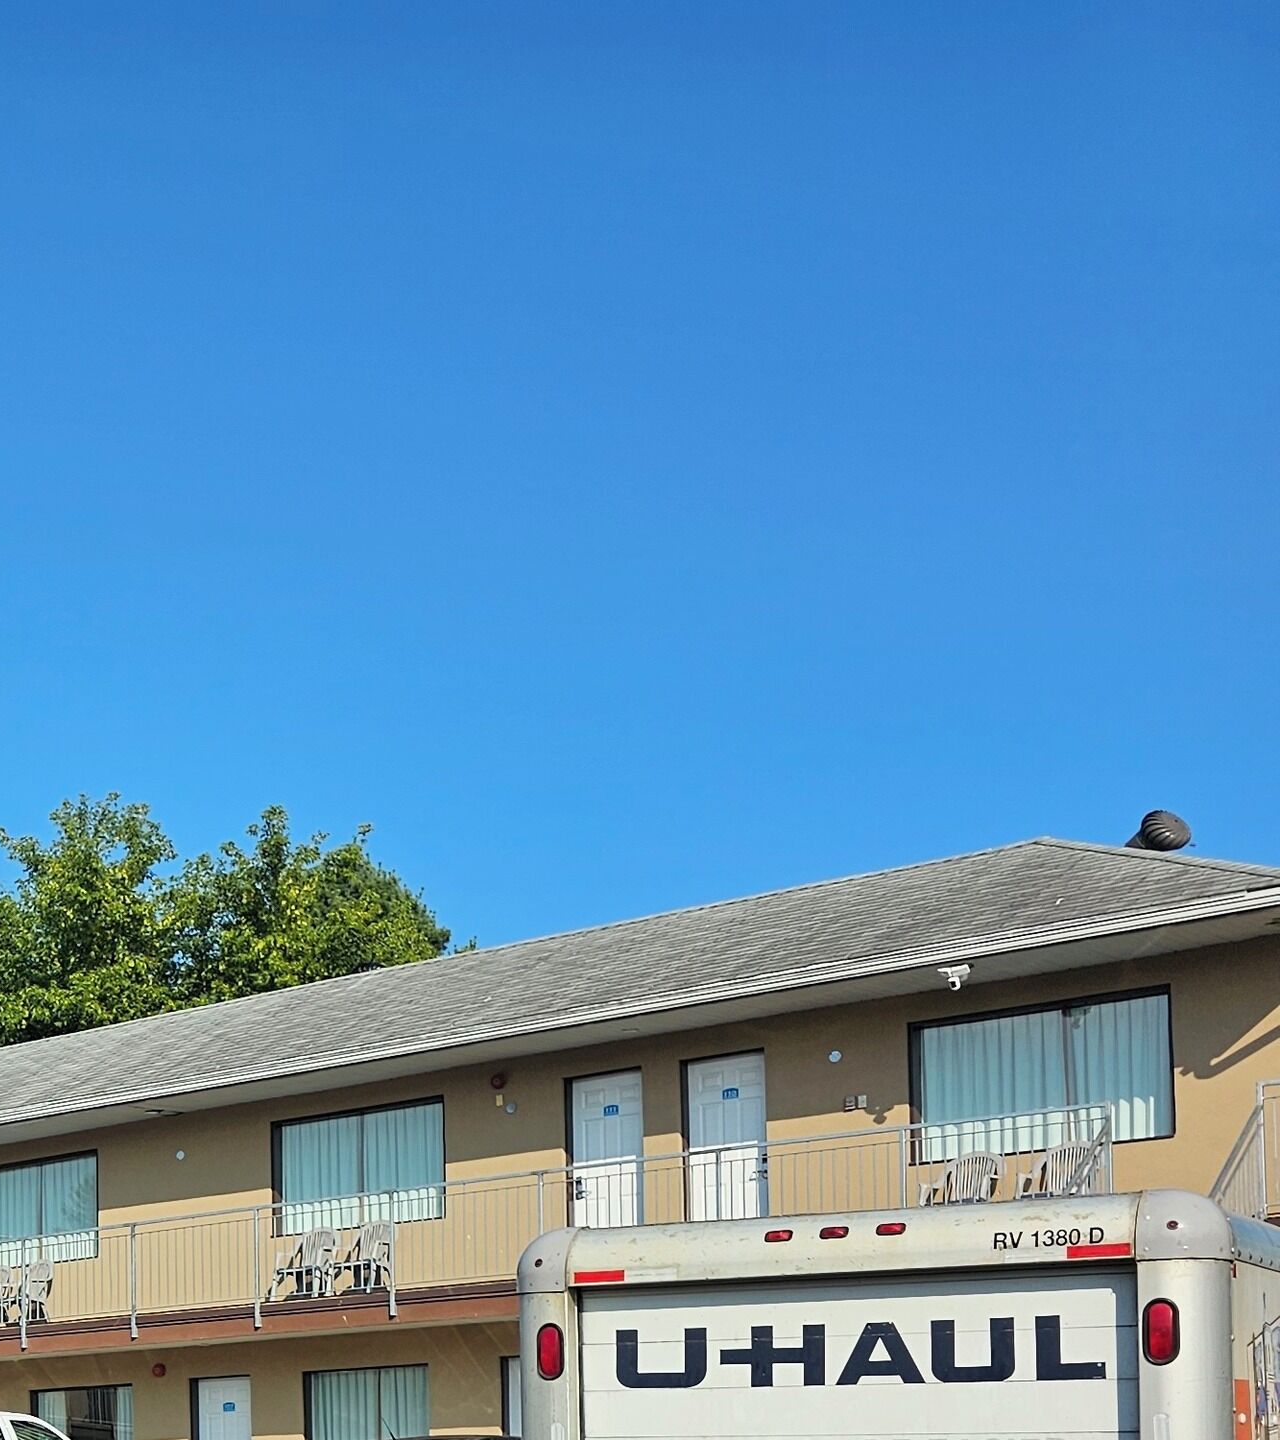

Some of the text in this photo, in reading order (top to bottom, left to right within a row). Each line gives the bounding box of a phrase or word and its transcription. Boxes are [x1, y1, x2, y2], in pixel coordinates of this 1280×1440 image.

[993, 1227, 1105, 1250] RV 1380 D
[615, 1315, 1106, 1388] U-HAUL
